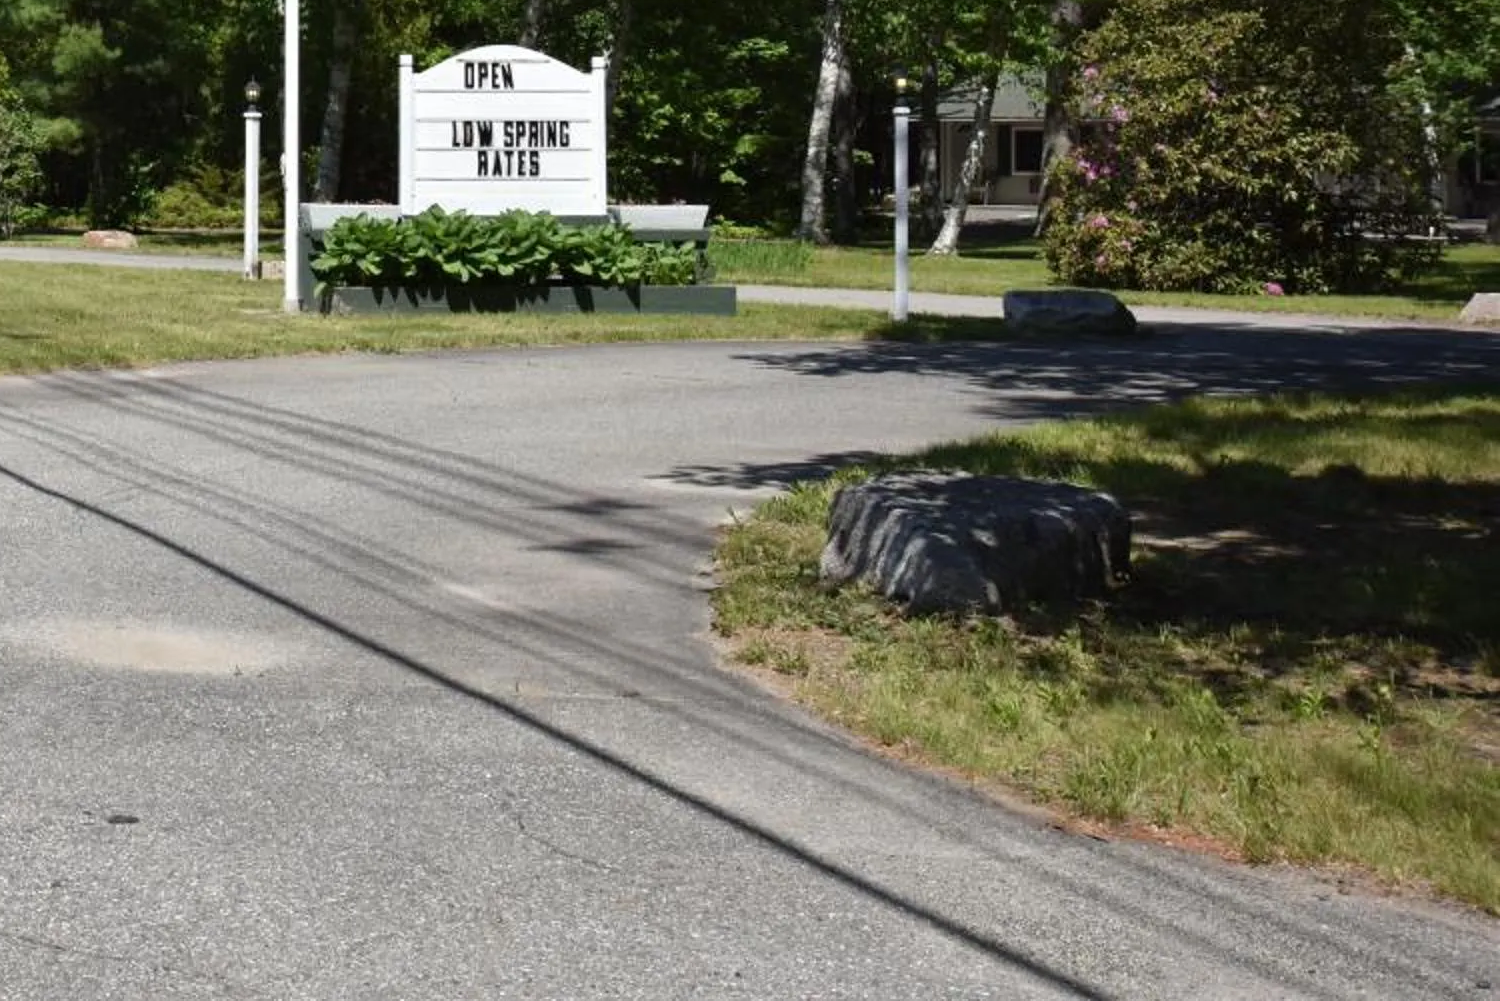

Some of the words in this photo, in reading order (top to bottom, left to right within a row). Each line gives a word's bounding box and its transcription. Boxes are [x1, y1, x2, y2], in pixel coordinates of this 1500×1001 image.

[464, 61, 515, 89] OPEN
[451, 120, 493, 148] LOW
[503, 120, 571, 148] SPRING
[477, 150, 541, 177] RATES
